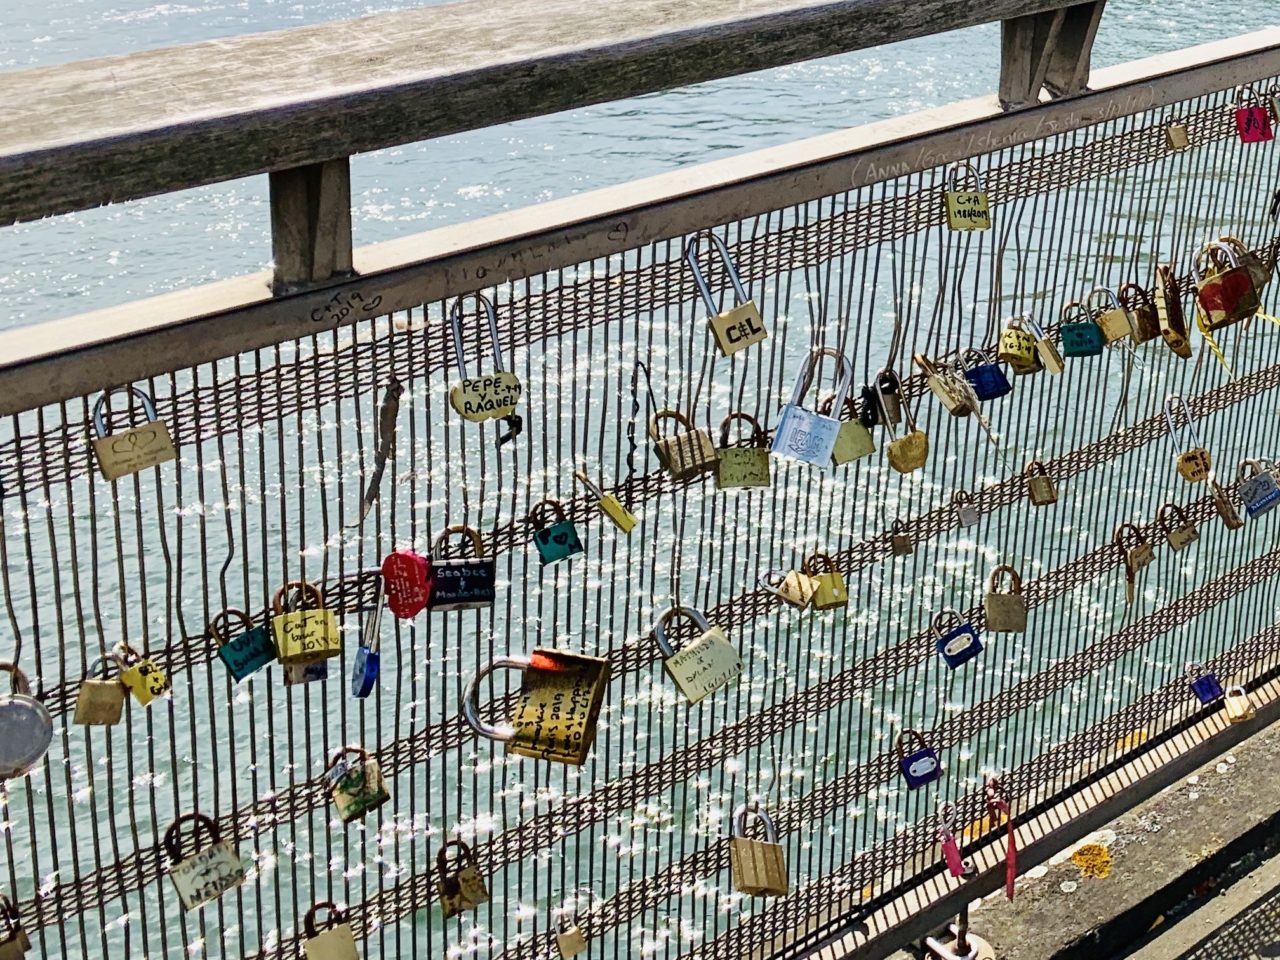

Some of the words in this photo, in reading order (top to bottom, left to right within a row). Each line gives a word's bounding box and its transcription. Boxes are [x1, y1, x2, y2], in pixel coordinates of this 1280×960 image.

[331, 291, 364, 324] 2019
[462, 377, 502, 394] PEPE
[464, 395, 518, 415] RAQUEL
[551, 692, 564, 721] 2019
